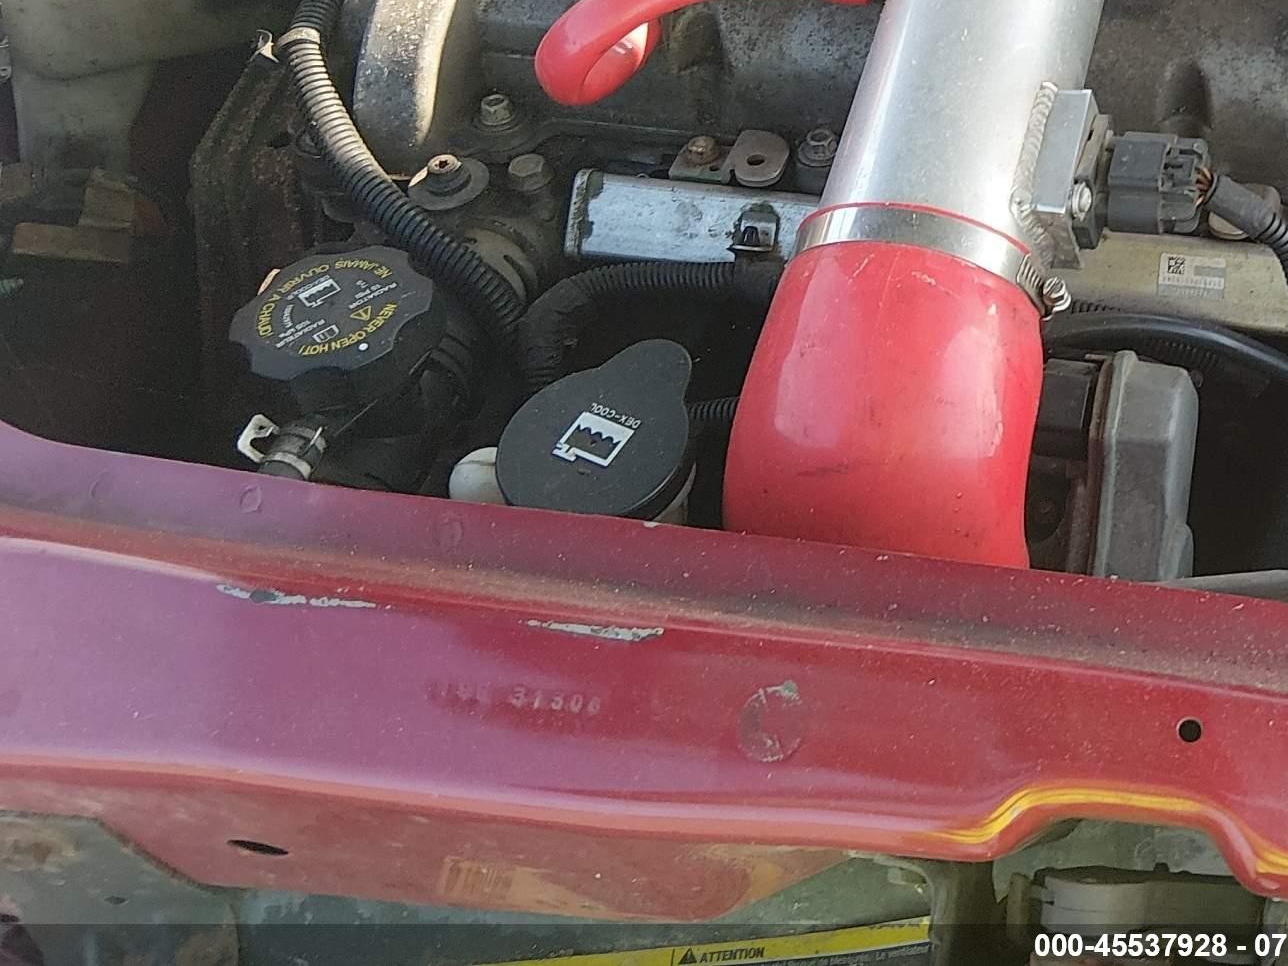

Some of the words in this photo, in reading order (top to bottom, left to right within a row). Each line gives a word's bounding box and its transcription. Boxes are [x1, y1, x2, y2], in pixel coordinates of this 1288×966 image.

[280, 264, 330, 293] OUVRIR
[363, 302, 398, 333] NEVER
[298, 342, 330, 357] HOT!
[330, 330, 367, 351] OPEN
[590, 402, 641, 429] DEX-COOL
[700, 946, 765, 964] ATTENTION
